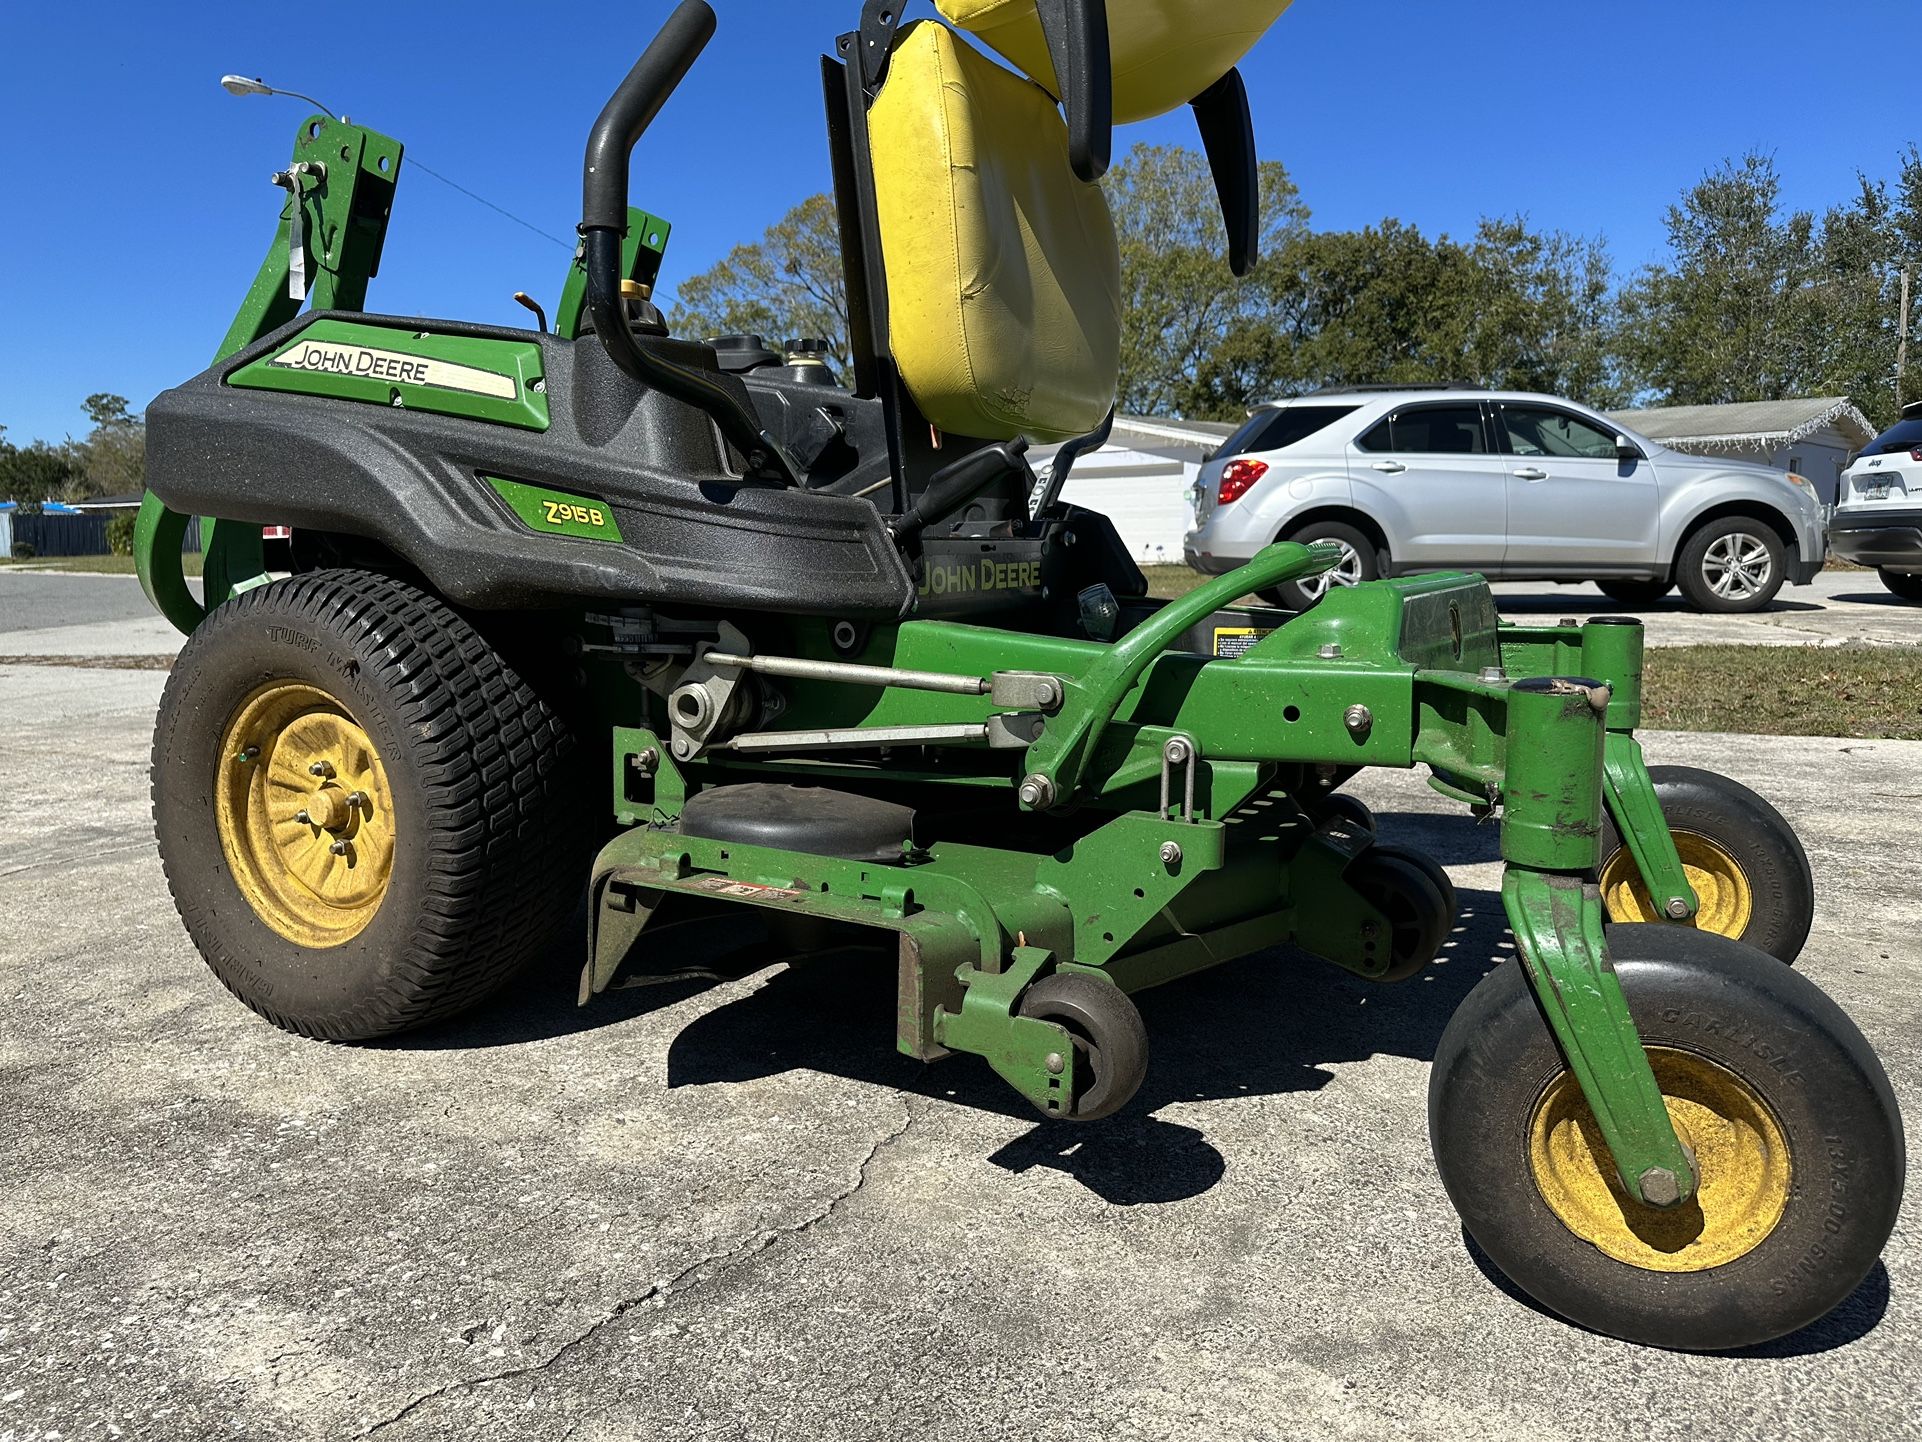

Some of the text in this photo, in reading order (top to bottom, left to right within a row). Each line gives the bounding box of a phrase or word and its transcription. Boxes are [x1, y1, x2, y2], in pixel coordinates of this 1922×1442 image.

[294, 345, 429, 382] JOHN DEERE
[542, 500, 605, 526] Z915B
[918, 558, 1041, 595] JOHN DEERE
[268, 625, 322, 653] TURF
[1664, 804, 1730, 826] RLISLE
[1661, 1007, 1807, 1085] CARLISLE
